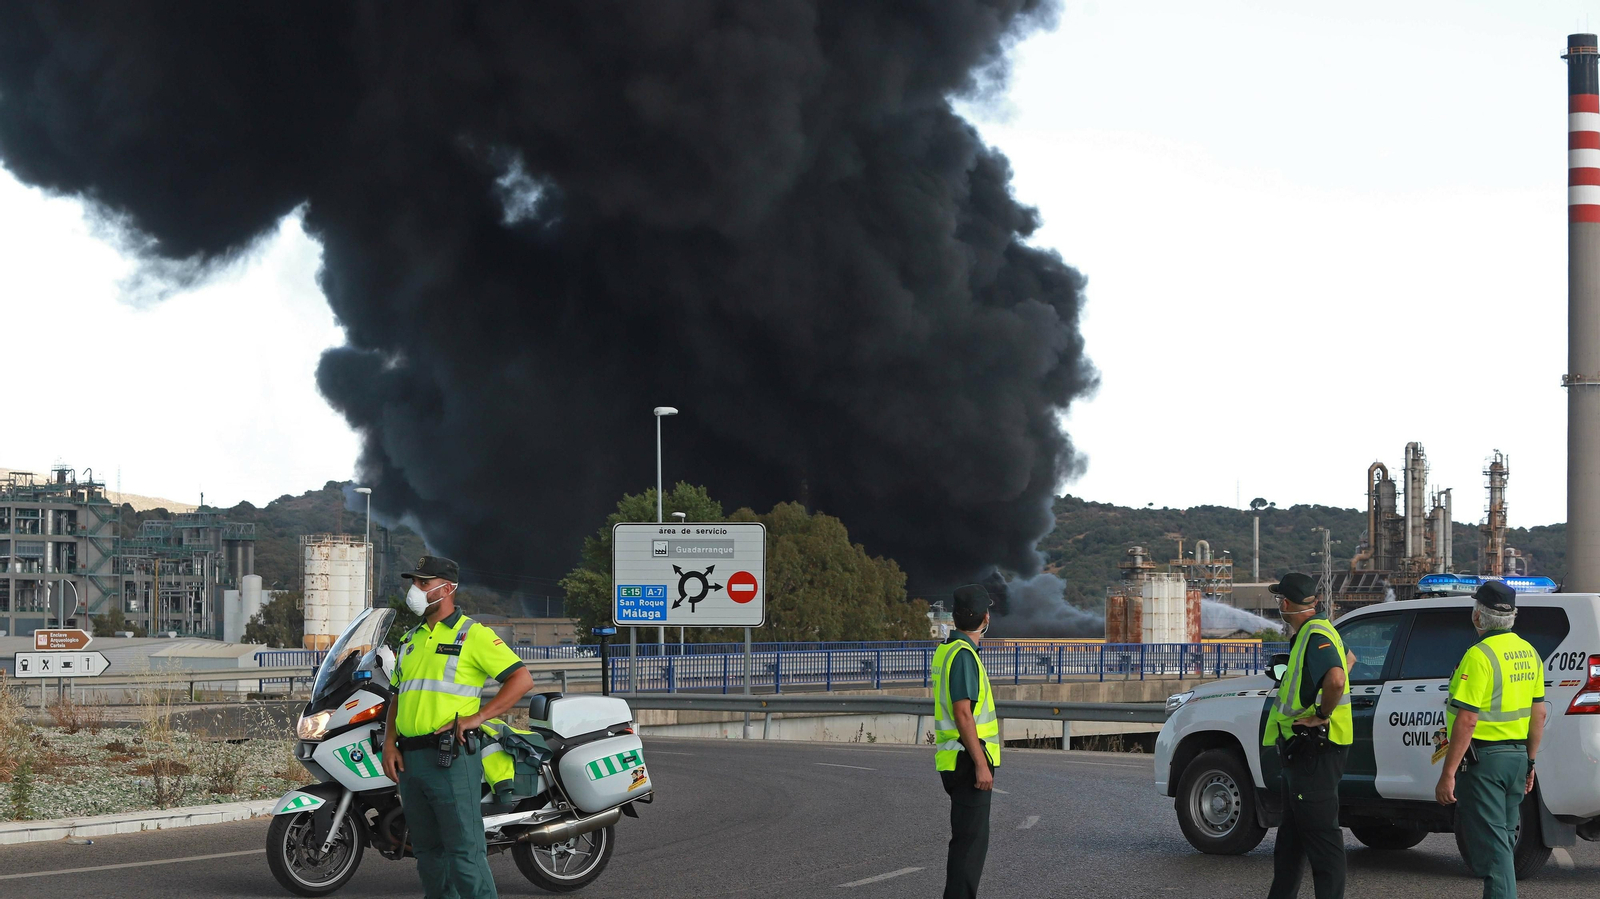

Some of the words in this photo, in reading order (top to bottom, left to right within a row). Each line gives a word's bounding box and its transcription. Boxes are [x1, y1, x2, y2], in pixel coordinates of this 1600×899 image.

[658, 527, 676, 535] área
[681, 527, 691, 535] de
[695, 527, 728, 535] servicio
[675, 545, 733, 554] Guadarranque
[621, 588, 641, 596] E-15
[647, 588, 663, 596] A-7
[639, 599, 665, 608] Roque
[622, 608, 661, 620] Málaga
[1503, 650, 1533, 661] GUARDIA
[1513, 661, 1531, 671] CIVIL
[1559, 651, 1586, 671] 062
[1509, 672, 1535, 683] TRAFICO
[1388, 711, 1445, 727] GUARDIA
[1402, 731, 1431, 747] CIVIL
